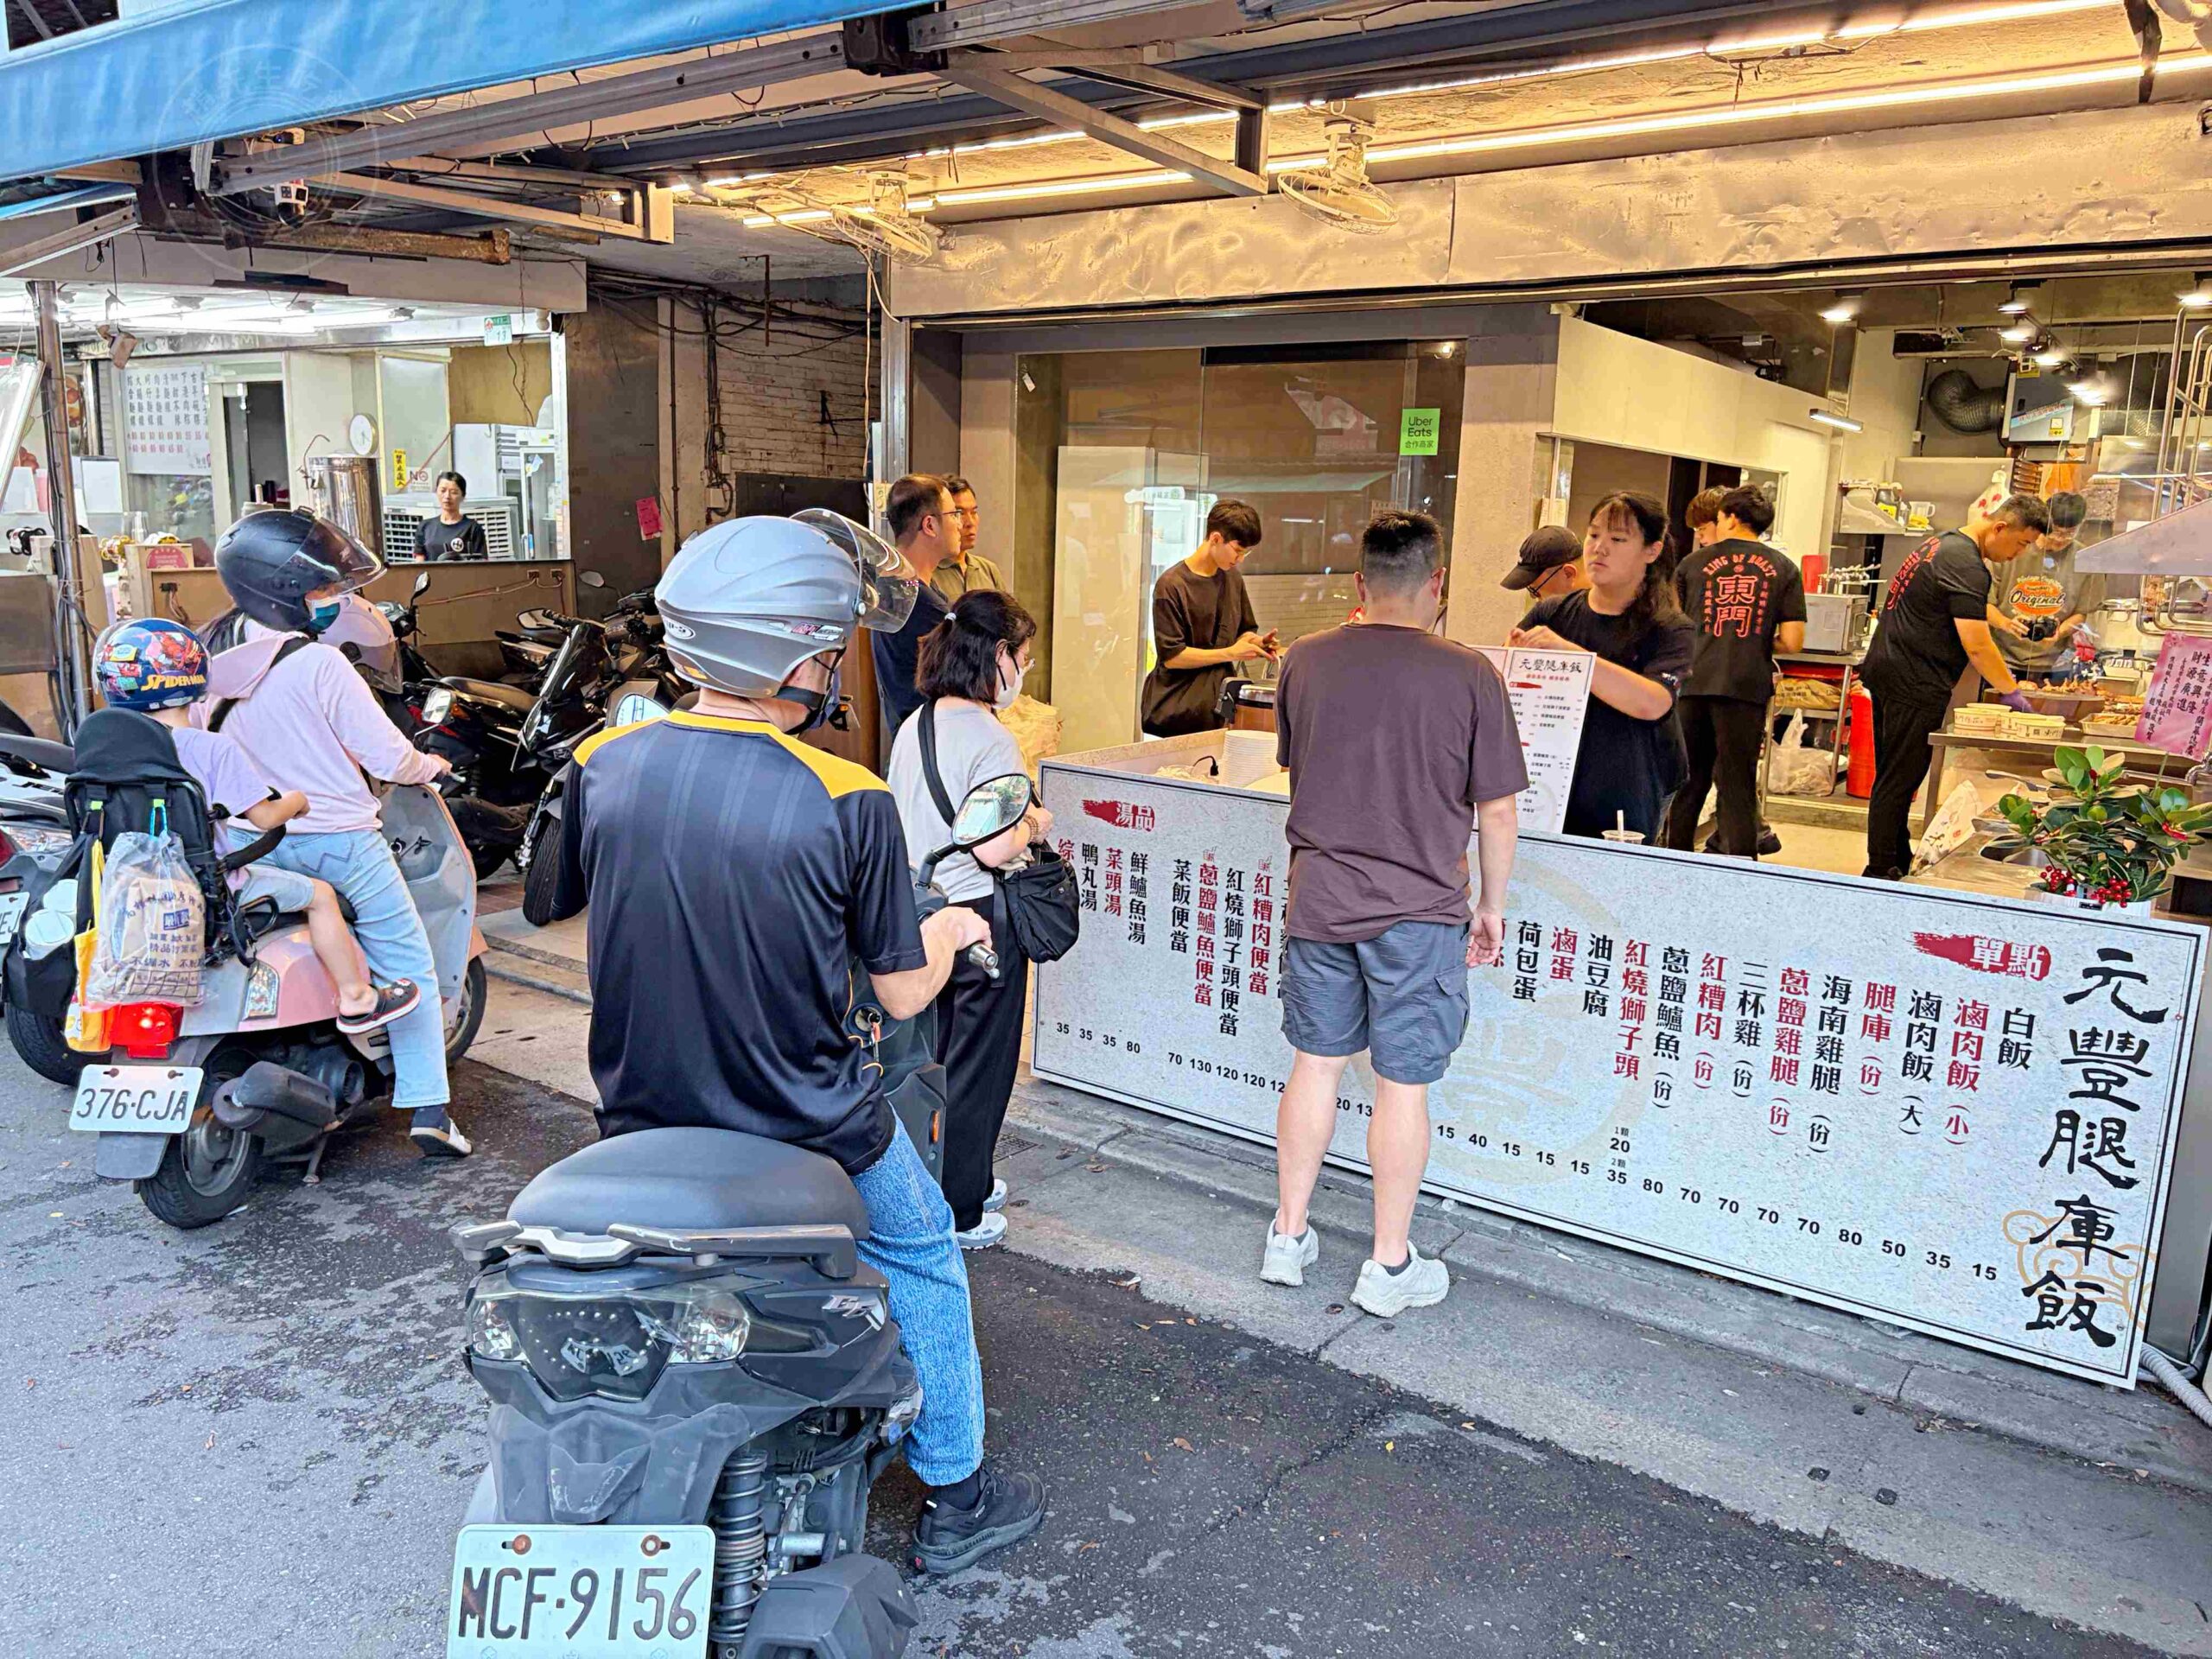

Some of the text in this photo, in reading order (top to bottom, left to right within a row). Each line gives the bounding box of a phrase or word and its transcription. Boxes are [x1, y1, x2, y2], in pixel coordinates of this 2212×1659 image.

[1408, 416, 1433, 426] Uber
[1408, 427, 1433, 437] Eats
[1713, 575, 1758, 638] 東門
[1115, 802, 1154, 830] 湯品
[1080, 842, 1098, 912] 鴨丸湯
[1104, 848, 1123, 917] 菜頭湯
[1170, 859, 1192, 954] 菜飯便當
[1249, 873, 1274, 995] 紅糟肉便當
[1219, 868, 1244, 1037] 紅燒獅子頭便當
[1513, 920, 1542, 1002] 荷包蛋
[1549, 926, 1578, 982] 滷蛋
[1970, 938, 2047, 980] 單點
[1582, 933, 1613, 1017] 油豆腐
[1613, 939, 1650, 1081] 紅燒獅子頭
[1056, 1021, 1070, 1036] 35
[1079, 1027, 1093, 1041] 35
[1103, 1034, 1116, 1048] 35
[1126, 1041, 1141, 1054] 80
[1997, 1007, 2035, 1071] 白飯
[1168, 1052, 1183, 1065] 70
[1190, 1058, 1212, 1073] 130
[1216, 1065, 1238, 1081] 120
[1243, 1072, 1266, 1088] 120
[1437, 1124, 1455, 1139] 15
[1469, 1133, 1488, 1147] 40
[1502, 1141, 1521, 1157] 15
[1610, 1137, 1630, 1153] 20
[2021, 947, 2170, 1348] 元豐腿庫飯
[1536, 1151, 1554, 1166] 15
[1571, 1160, 1590, 1175] 15
[1607, 1169, 1627, 1185] 35
[1643, 1179, 1663, 1194] 80
[1681, 1187, 1701, 1204] 70
[1719, 1198, 1739, 1213] 70
[1758, 1207, 1779, 1224] 70
[1797, 1217, 1820, 1235] 70
[1839, 1228, 1863, 1246] 80
[1881, 1240, 1906, 1258] 50
[1926, 1250, 1951, 1269] 35
[1972, 1262, 1998, 1281] 15
